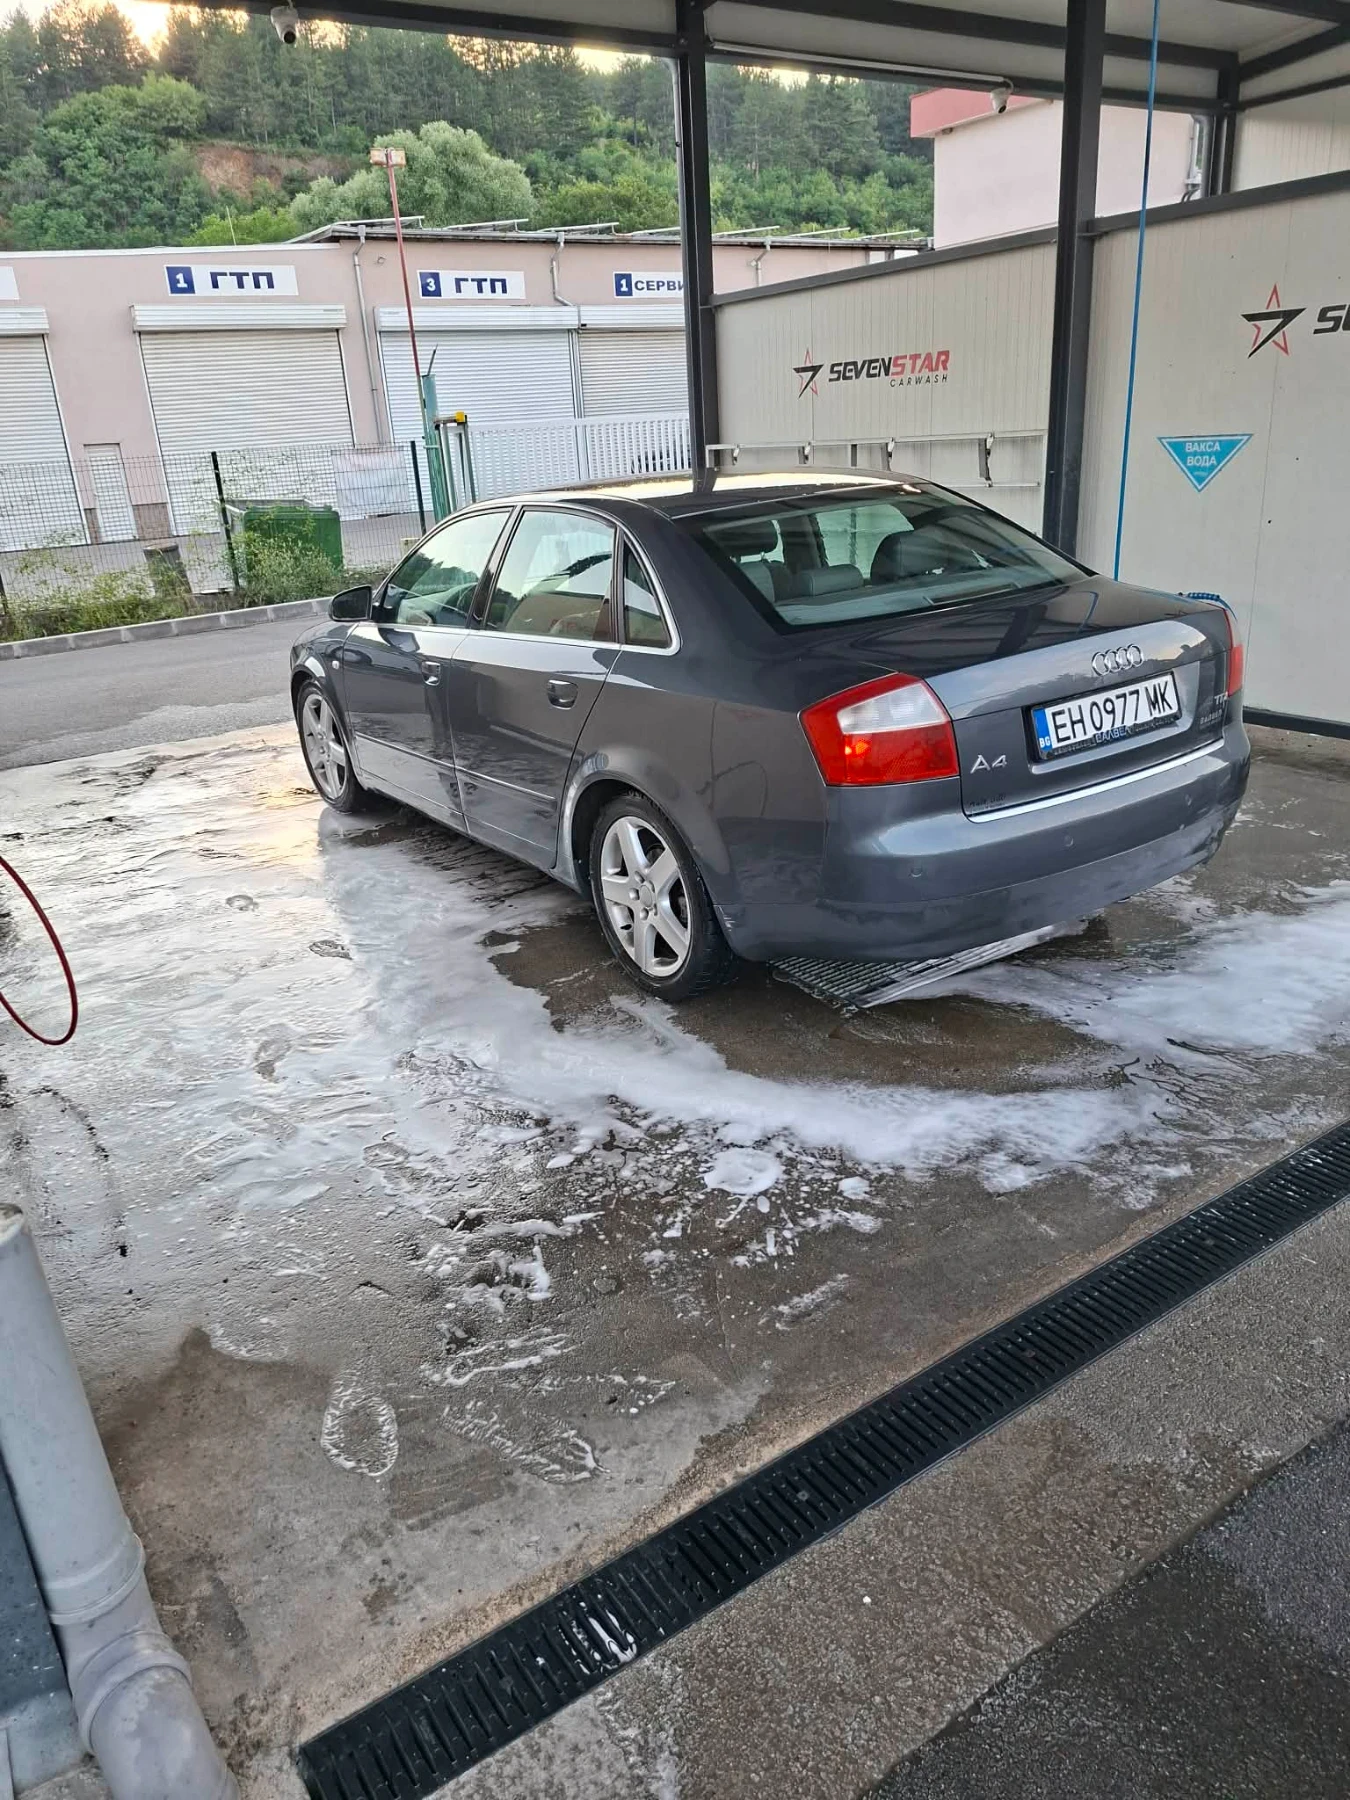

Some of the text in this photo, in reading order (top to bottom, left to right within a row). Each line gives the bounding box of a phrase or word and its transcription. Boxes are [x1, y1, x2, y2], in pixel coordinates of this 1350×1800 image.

[175, 271, 275, 289] 1 ГТП
[425, 277, 508, 294] 3 ГТП
[619, 278, 629, 292] 1
[1313, 304, 1350, 335] S
[889, 374, 948, 388] CARWASH
[1185, 441, 1221, 453] ВАКСА
[1186, 455, 1218, 468] ВОДА
[1051, 704, 1091, 743] EH
[1089, 688, 1140, 732] 0977
[1145, 680, 1174, 717] MK
[1039, 736, 1051, 748] BG
[970, 754, 1008, 774] A4
